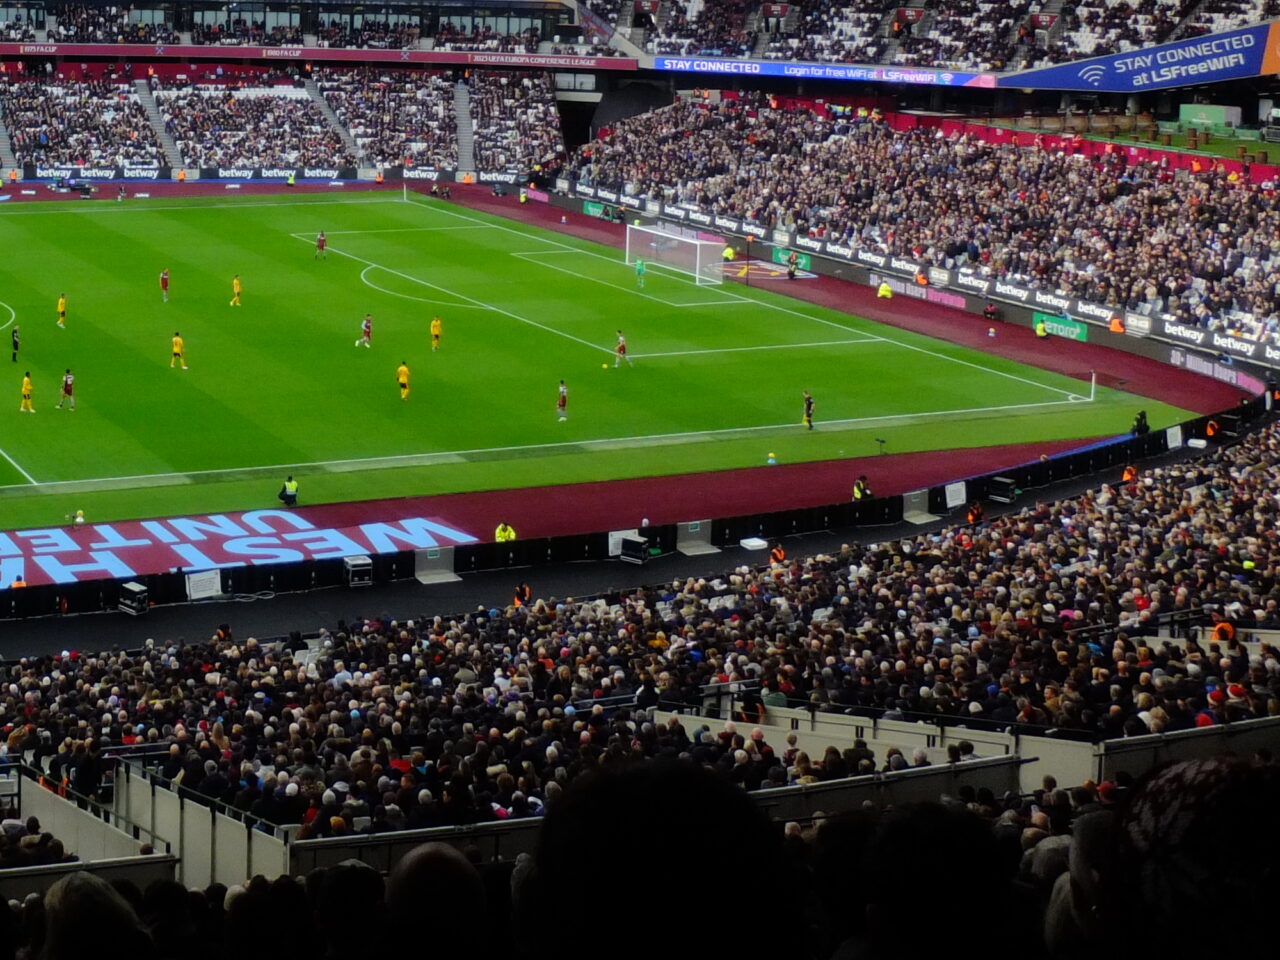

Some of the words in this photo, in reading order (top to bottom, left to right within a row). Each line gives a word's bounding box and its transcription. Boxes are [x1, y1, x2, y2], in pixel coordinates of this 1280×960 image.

[1113, 55, 1154, 73] STAY
[1156, 34, 1255, 65] CONNECTED
[530, 57, 570, 65] CONFERENCE
[571, 58, 596, 66] LEAGUE
[664, 60, 692, 70] STAY
[693, 60, 760, 73] CONNECTED
[784, 66, 809, 78] Login
[810, 67, 824, 76] for
[825, 68, 846, 77] free
[868, 70, 877, 78] at
[1132, 70, 1150, 86] at
[36, 168, 72, 179] betway
[80, 168, 115, 179] betway
[124, 168, 159, 179] betway
[219, 168, 254, 179] betway
[261, 168, 296, 179] betway
[304, 168, 339, 179] betway
[403, 169, 439, 180] betway
[480, 171, 516, 182] betway
[664, 204, 686, 219] betway
[689, 210, 711, 225] betway
[715, 216, 738, 231] betway
[742, 222, 766, 238] betway
[796, 234, 822, 252] betway
[826, 242, 853, 259] betway
[858, 250, 886, 267] betway
[891, 258, 921, 275] betway
[958, 273, 990, 291] betway
[995, 282, 1029, 301] betway
[1036, 291, 1070, 310] betway
[1078, 301, 1114, 322] betway
[1164, 322, 1205, 344] betway
[1213, 333, 1256, 356] betway
[168, 516, 480, 573] WEST
